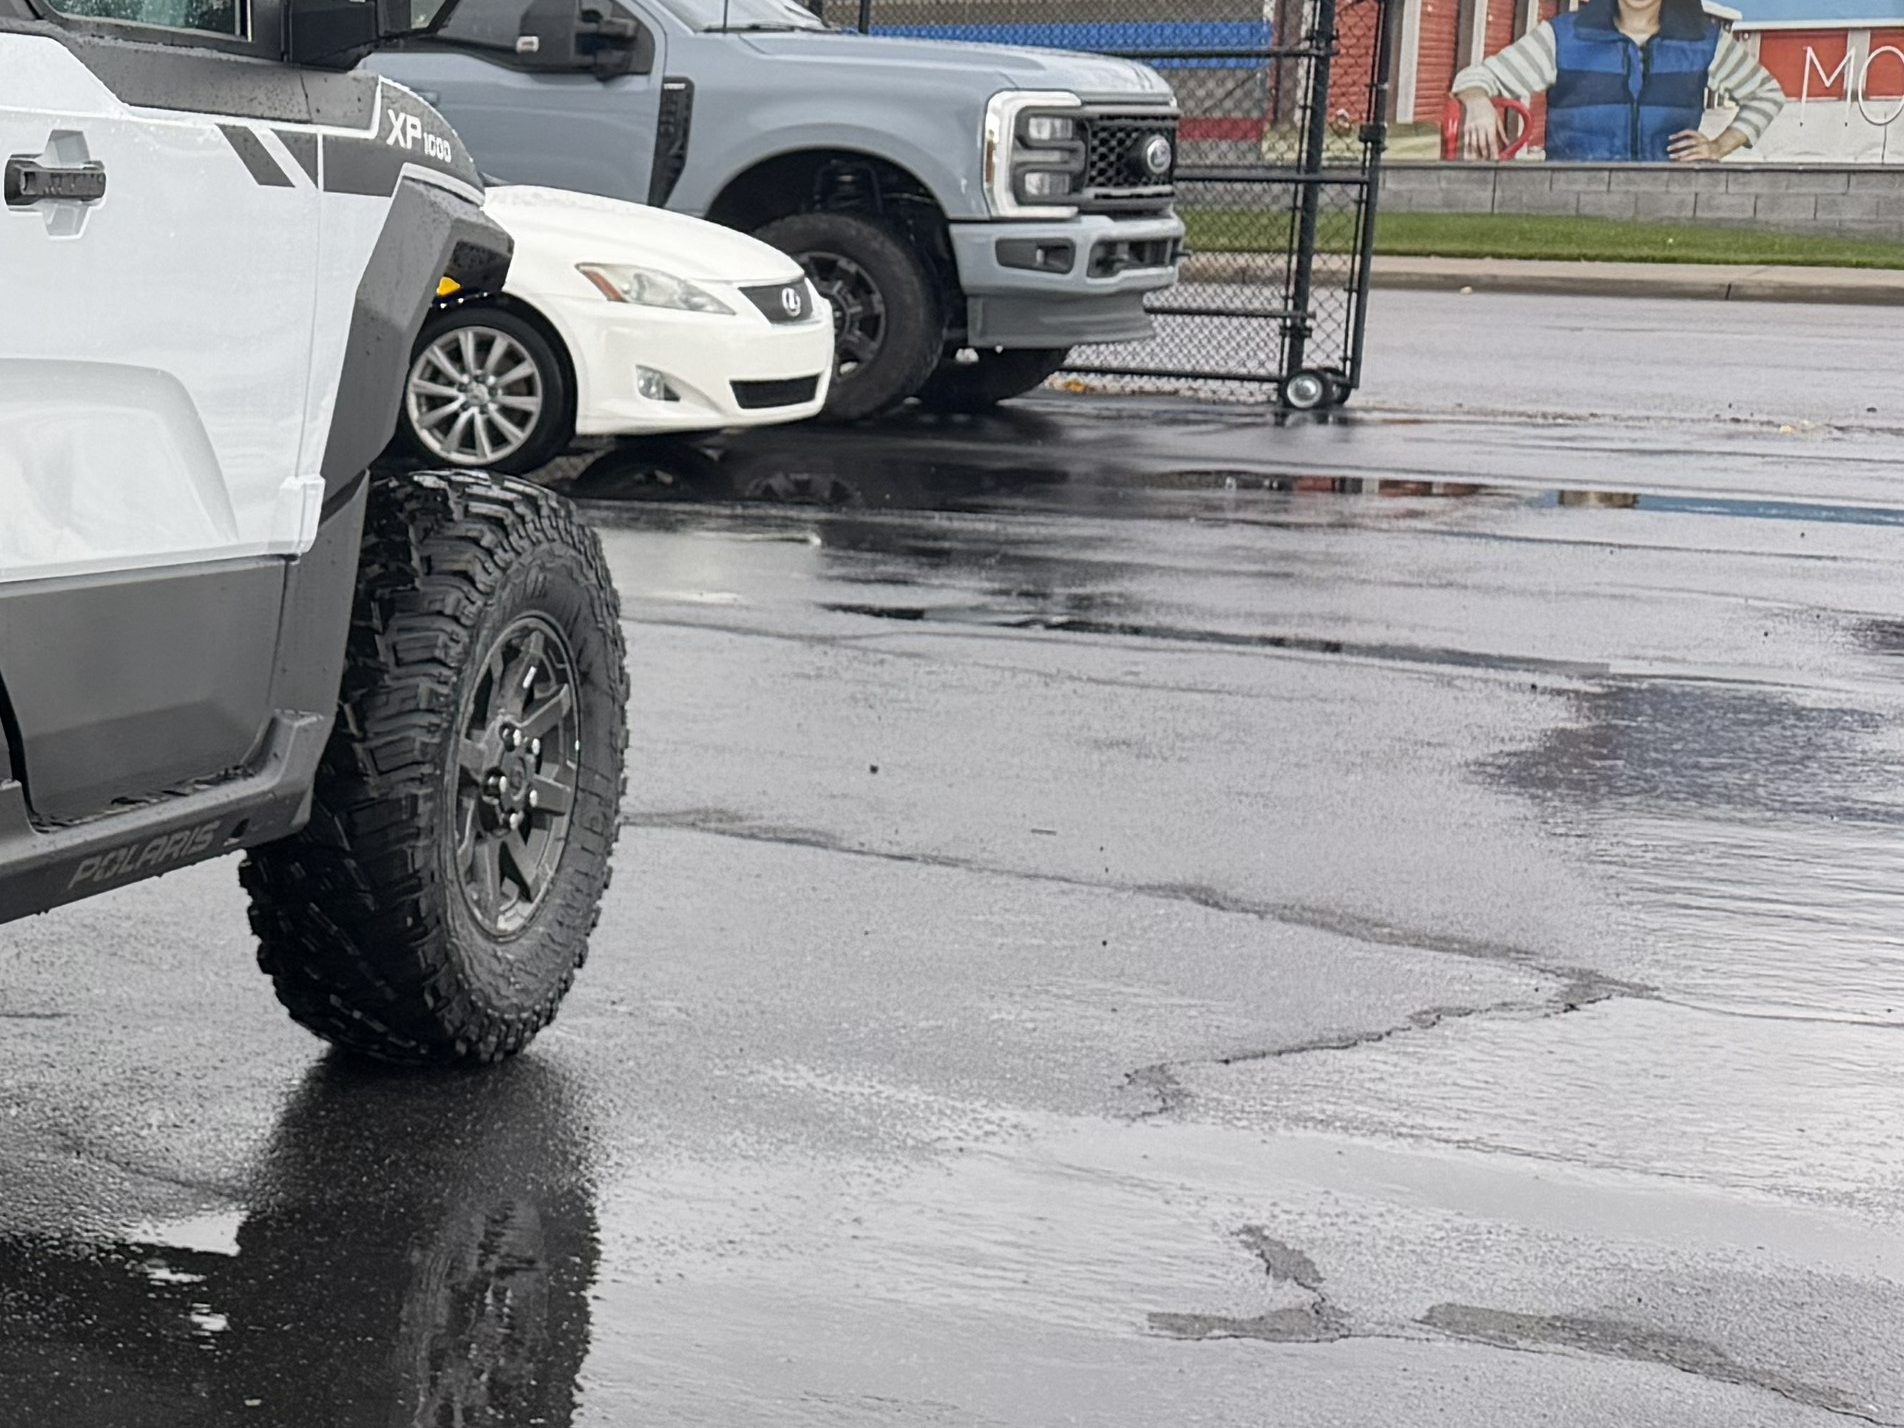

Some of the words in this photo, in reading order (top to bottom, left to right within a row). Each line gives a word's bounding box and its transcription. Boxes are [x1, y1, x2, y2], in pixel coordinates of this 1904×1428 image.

[386, 108, 422, 150] XP
[423, 131, 452, 163] 1000
[67, 820, 222, 890] POLARIS
